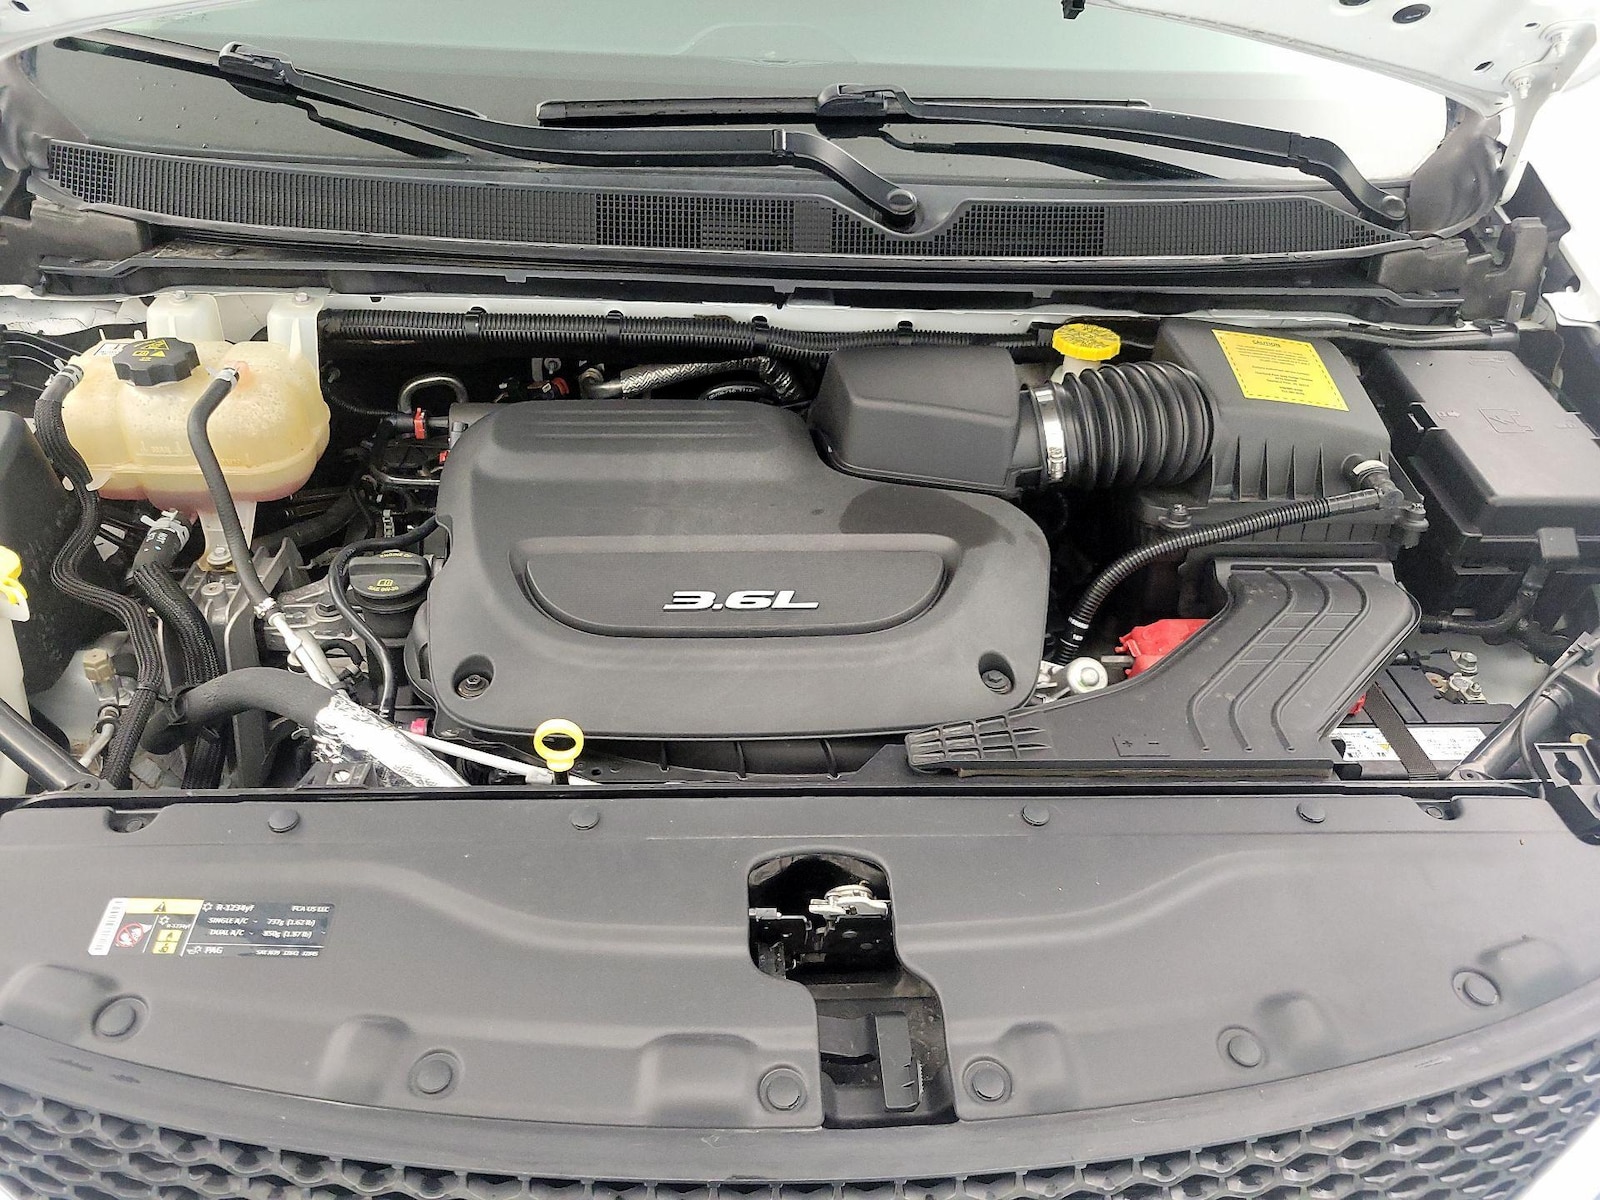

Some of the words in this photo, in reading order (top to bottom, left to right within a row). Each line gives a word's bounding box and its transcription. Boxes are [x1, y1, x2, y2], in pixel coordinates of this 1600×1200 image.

[1252, 340, 1281, 348] CAUTION
[662, 590, 819, 610] 3.6L
[215, 904, 255, 913] R-1234yf
[203, 946, 224, 954] PAG
